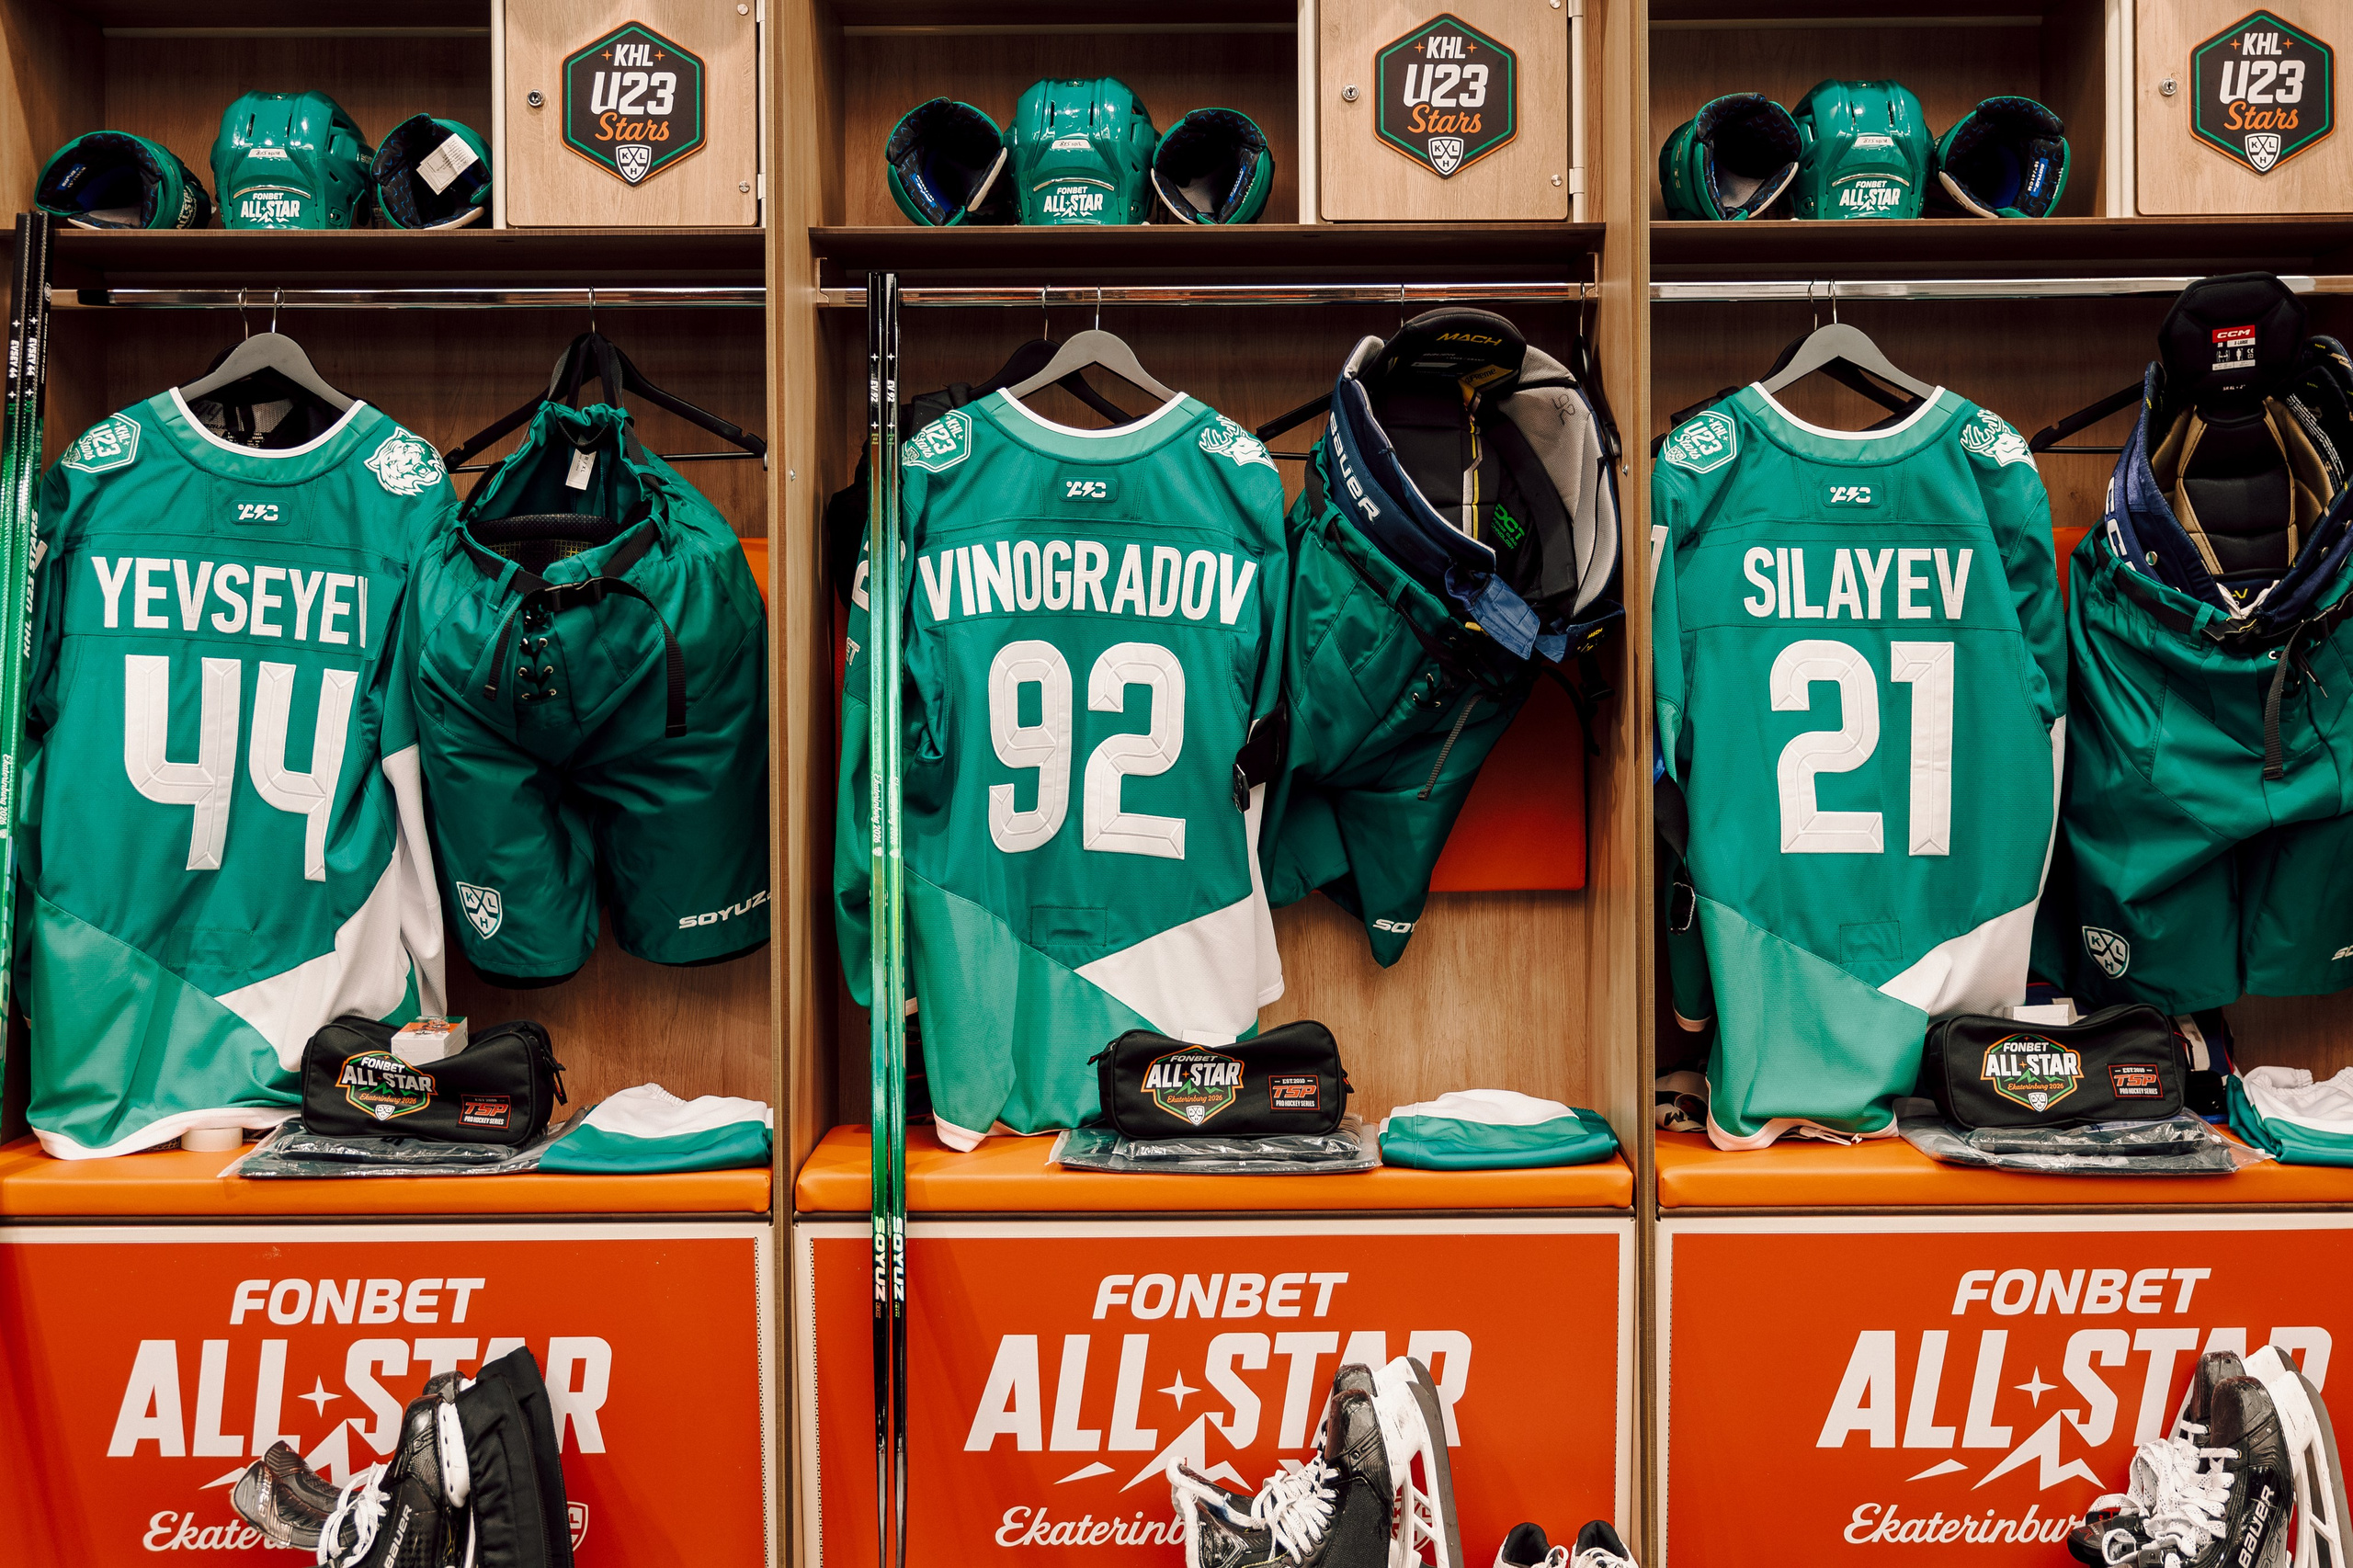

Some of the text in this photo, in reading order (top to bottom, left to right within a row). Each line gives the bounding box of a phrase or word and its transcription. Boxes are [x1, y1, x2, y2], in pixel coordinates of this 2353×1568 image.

[613, 44, 654, 66] KHL
[1427, 36, 1466, 59] KHL
[2243, 33, 2281, 55] KHL
[590, 72, 677, 115] U23
[1403, 63, 1489, 108] U23
[2220, 60, 2305, 104] U23
[594, 111, 670, 142] Stars
[1407, 104, 1482, 133] Stars
[2223, 100, 2299, 131] Stars
[253, 192, 284, 200] FONBET
[1056, 186, 1088, 194] FONBET
[1839, 187, 1901, 207] ALL STAR
[1855, 180, 1887, 188] FONBET
[241, 199, 301, 218] ALL STAR
[1043, 193, 1103, 213] ALL STAR
[1436, 333, 1503, 347] MACH
[2217, 329, 2251, 339] CCM
[9, 340, 19, 363] EVSEY
[27, 337, 38, 365] EVSEY
[870, 380, 879, 403] EV 92
[887, 380, 895, 403] EV 92
[89, 423, 121, 458] U23
[921, 419, 956, 456] U23
[1683, 422, 1722, 456] U23
[1709, 420, 1726, 438] KHL
[78, 435, 97, 460] Stars
[911, 431, 936, 459] Stars
[1674, 433, 1701, 460] Stars
[1328, 411, 1382, 527] BAUER
[2105, 477, 2137, 572] CC
[23, 508, 39, 658] KHL U23 STARS
[917, 540, 1257, 625] VINOGRADOV
[1743, 546, 1973, 619] SILAYEV
[988, 639, 1186, 860] 92
[1769, 639, 1955, 857] 21
[124, 653, 359, 882] 44
[871, 773, 883, 843] Ekaterinburg 2026
[678, 891, 767, 930] SOYUZ
[2003, 1041, 2049, 1052] FONBET
[360, 1056, 405, 1074] FONBET
[1146, 1062, 1241, 1088] ALL STAR
[1984, 1052, 2079, 1077] ALL STAR
[341, 1065, 434, 1093] ALL STAR
[1272, 1085, 1317, 1098] TSP
[2007, 1083, 2048, 1091] Ekaterinburg
[2114, 1074, 2156, 1086] TSP
[358, 1092, 417, 1105] Ekaterinburg 2026
[464, 1101, 509, 1117] TSP
[1166, 1095, 1208, 1104] Ekaterinburg
[473, 1116, 489, 1124] HOCKEY
[489, 1117, 505, 1125] SERIES
[874, 1216, 886, 1302] SOYUZ
[892, 1216, 904, 1301] SOYUZ
[229, 1277, 486, 1325] FONBET
[1092, 1271, 1349, 1320] FONBET
[1951, 1267, 2211, 1316] FONBET
[106, 1338, 301, 1458] ALL
[963, 1333, 1158, 1452] ALL
[1815, 1329, 2013, 1449] ALL
[995, 1505, 1188, 1548] Ekaterinb
[1843, 1501, 2085, 1545] Ekaterinbur
